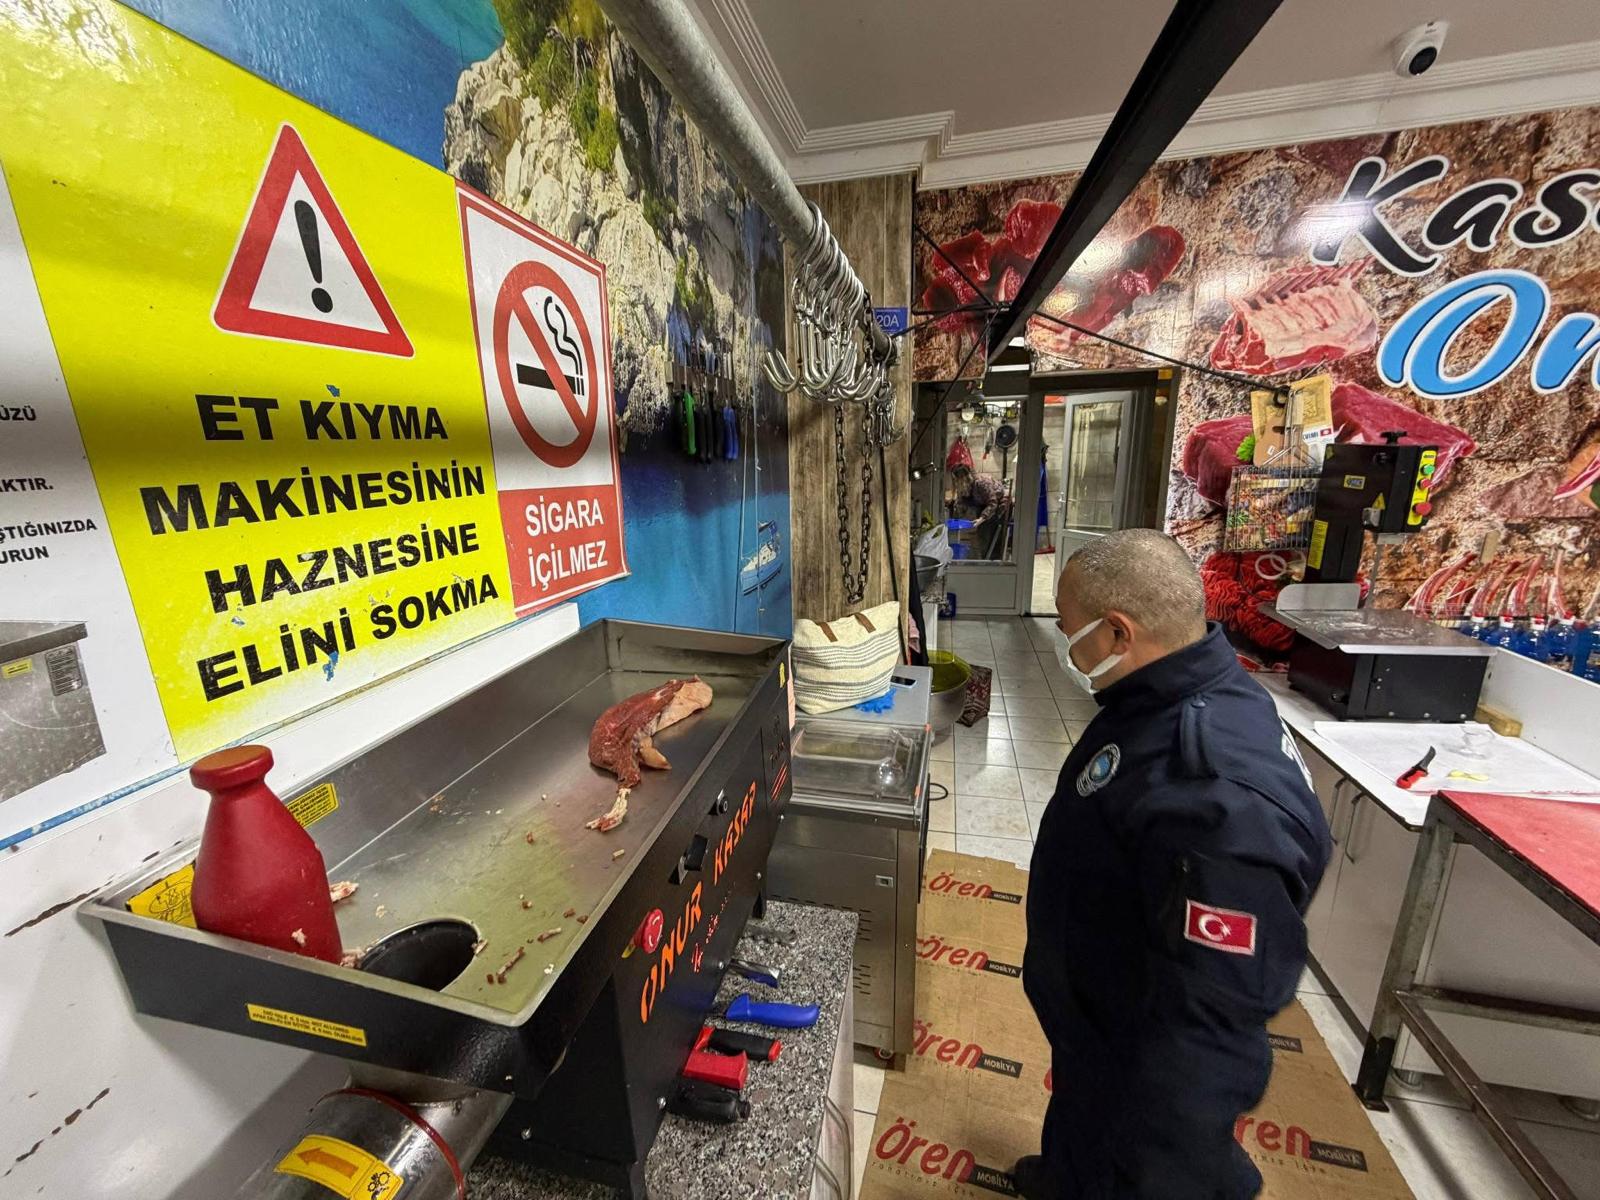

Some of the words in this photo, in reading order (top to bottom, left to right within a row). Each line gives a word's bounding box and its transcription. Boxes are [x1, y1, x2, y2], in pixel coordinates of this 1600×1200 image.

[1309, 154, 1600, 278] Kas
[876, 314, 900, 328] 20A
[195, 394, 279, 440] ET
[300, 400, 448, 440] KIYMA
[140, 460, 485, 535] MAKİNESİNİN
[525, 495, 604, 537] SİGARA
[205, 523, 480, 614] HAZNESİNE
[527, 540, 608, 591] İÇİLMEZ
[197, 607, 356, 702] ELİNİ
[370, 574, 499, 640] SOKMA
[641, 880, 703, 1024] ONUR
[714, 781, 757, 886] KASAP
[929, 872, 993, 899] Ören
[916, 935, 989, 971] Ören
[989, 962, 1017, 975] MOBİLYA
[983, 1057, 1016, 1074] MOBİLYA
[1268, 1037, 1298, 1049] OBİLYA
[875, 1116, 976, 1184] Ören
[976, 1171, 1015, 1192] MOBİLYA
[1234, 1114, 1312, 1160] ren
[1316, 1147, 1361, 1166] MOBİLYA
